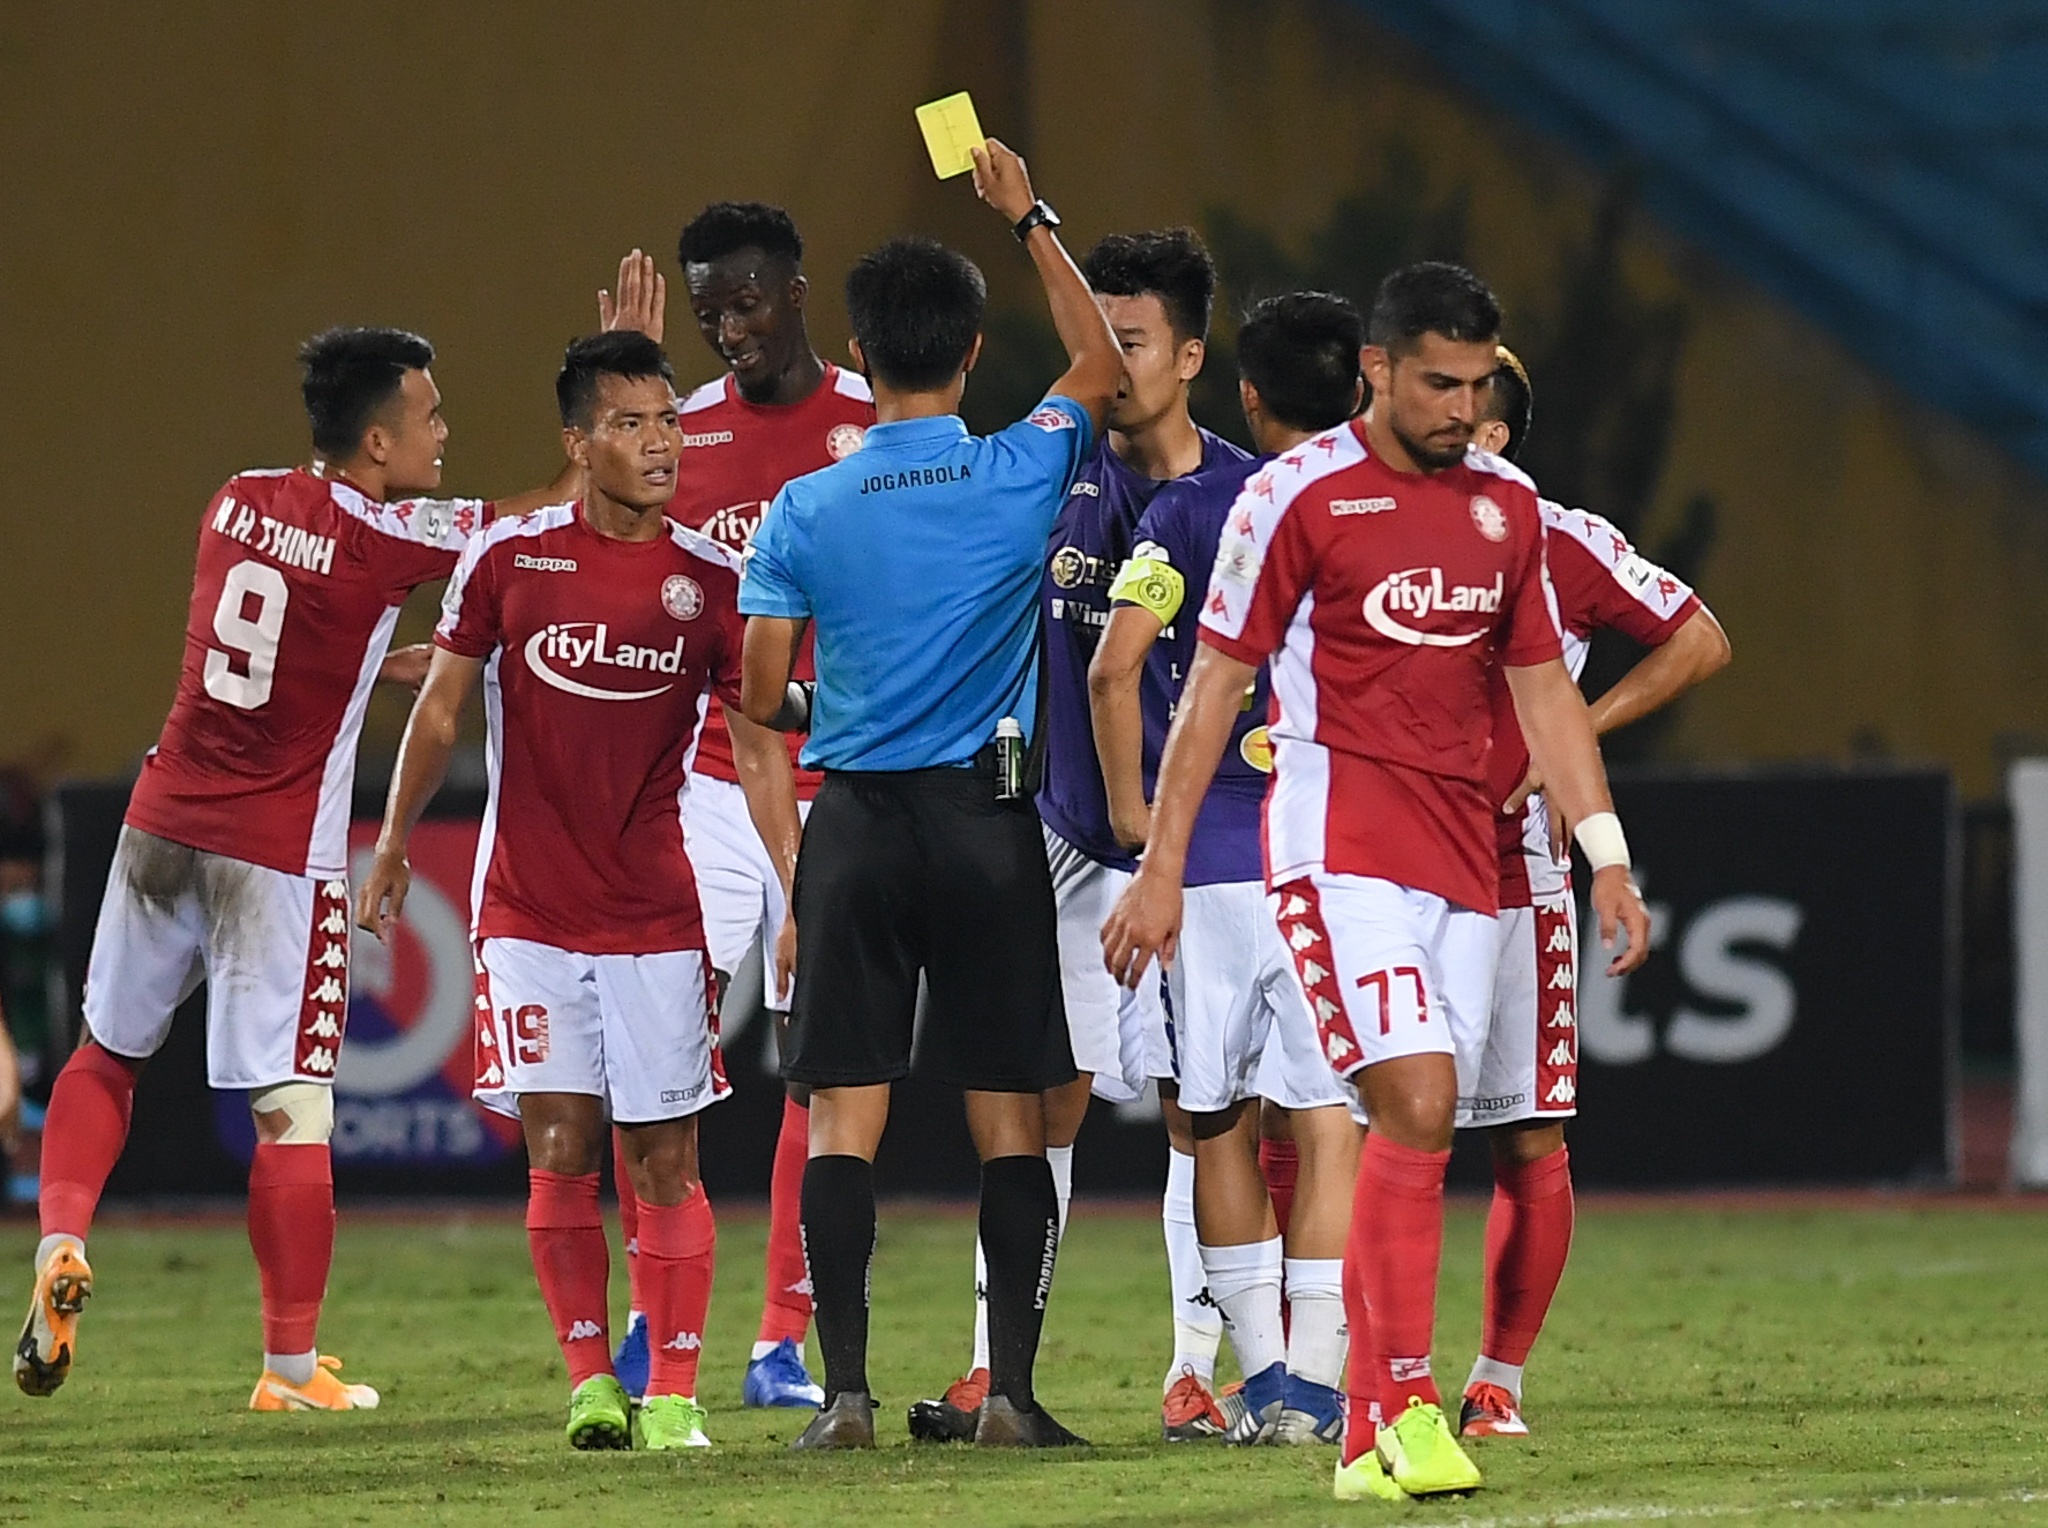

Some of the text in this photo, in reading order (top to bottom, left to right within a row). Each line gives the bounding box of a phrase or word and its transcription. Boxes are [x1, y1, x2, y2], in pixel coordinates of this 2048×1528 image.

[861, 465, 971, 494] JOGARBOLA
[1330, 497, 1397, 516] Kappa
[257, 516, 337, 576] THINH
[515, 554, 577, 572] Kappa
[203, 559, 289, 710] 9
[1355, 966, 1428, 1036] 77
[502, 1004, 550, 1067] 19
